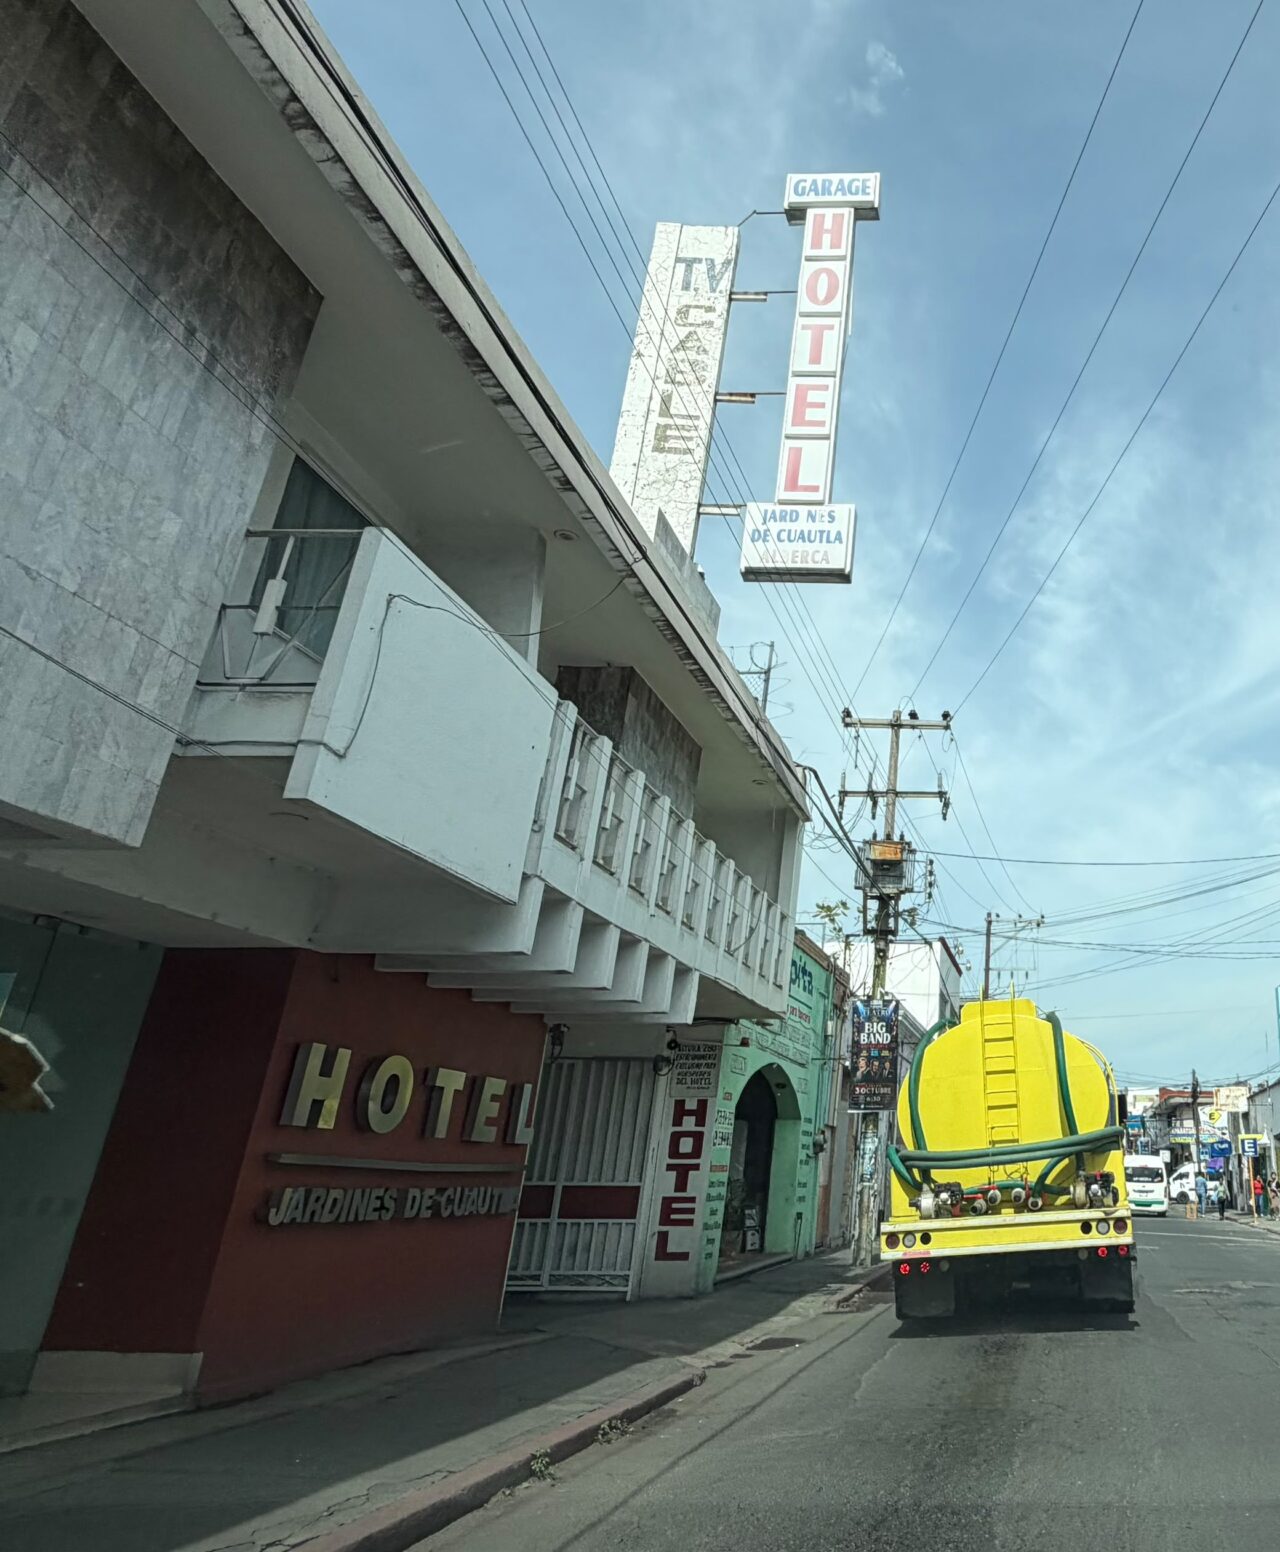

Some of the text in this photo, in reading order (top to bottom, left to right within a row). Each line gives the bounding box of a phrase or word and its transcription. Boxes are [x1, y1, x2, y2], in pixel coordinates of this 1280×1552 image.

[793, 178, 871, 197] GARAGE
[676, 256, 734, 294] TV
[783, 213, 845, 493] HOTEL
[761, 509, 836, 525] JARDNES
[751, 529, 843, 544] DE CUAUTLA
[864, 1022, 887, 1033] BIG
[860, 1033, 891, 1044] BAND
[690, 1077, 712, 1085] HOTEL
[280, 1042, 534, 1144] HOTEL
[1244, 1139, 1255, 1152] E
[654, 1098, 708, 1261] HOTEL
[267, 1187, 398, 1226] JARDINES
[403, 1187, 436, 1218] DE
